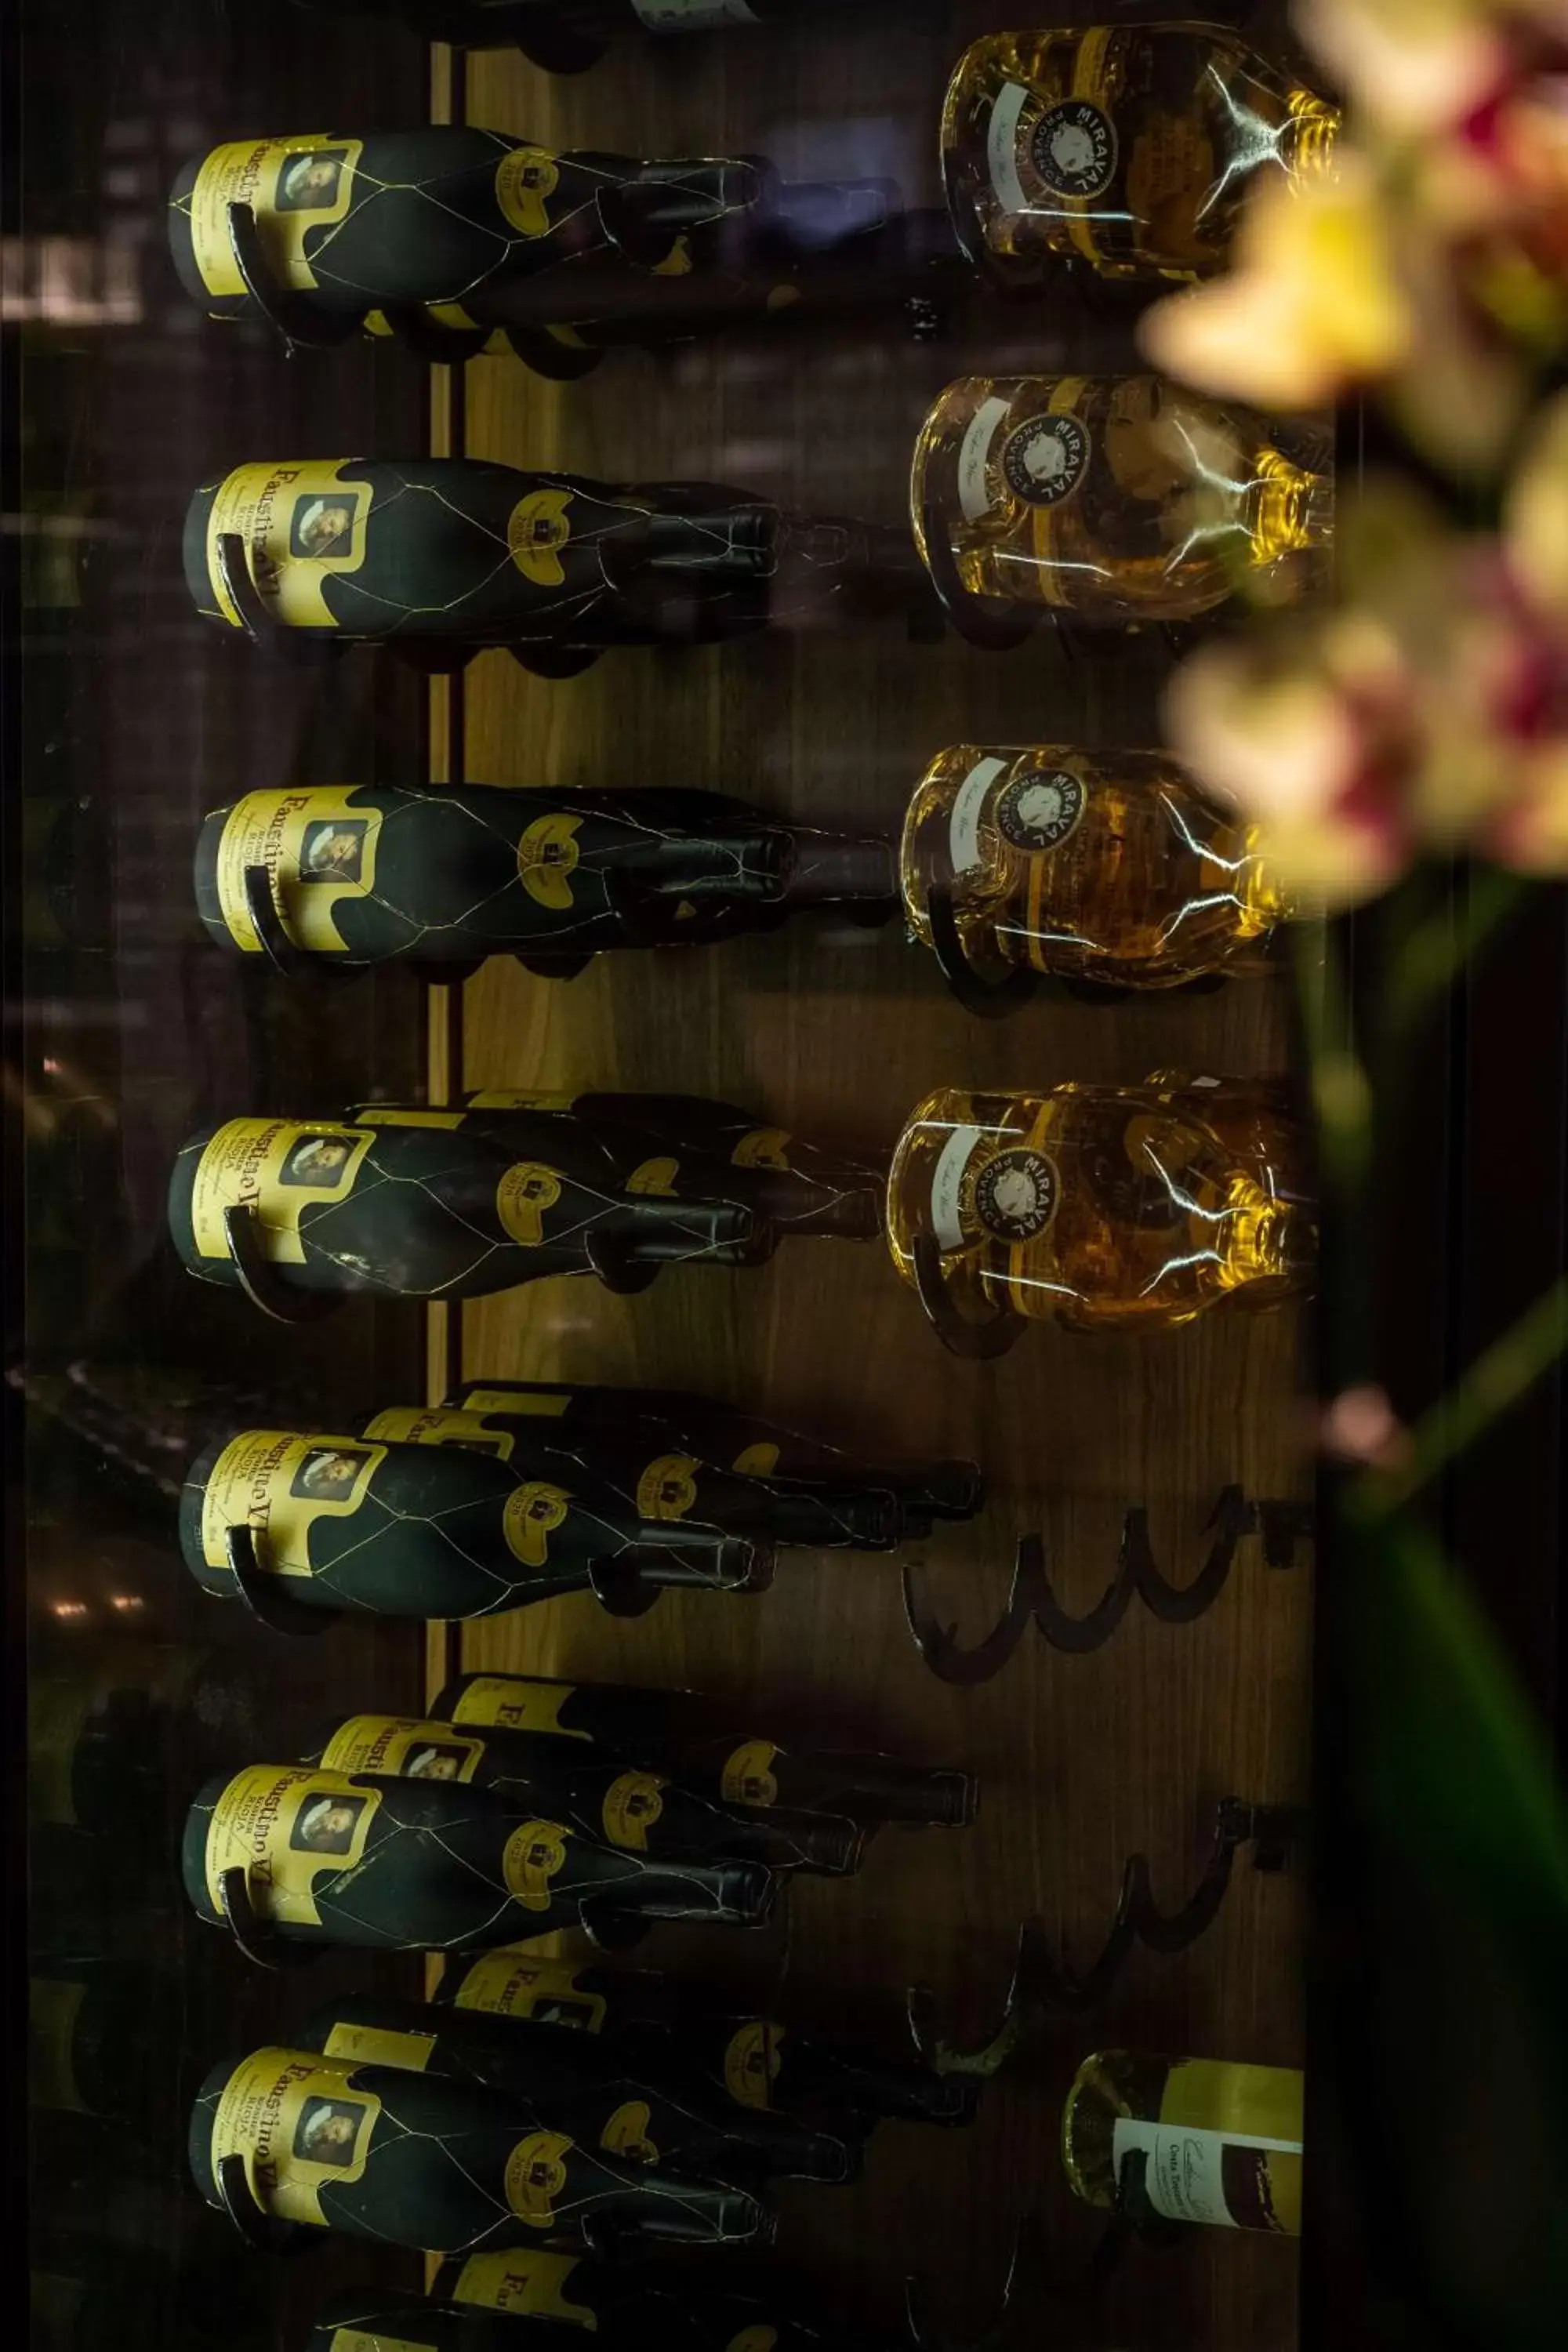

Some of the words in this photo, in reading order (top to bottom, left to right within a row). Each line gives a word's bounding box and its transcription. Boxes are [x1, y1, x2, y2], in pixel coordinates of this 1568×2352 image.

[1034, 110, 1067, 187] PROVENCE
[1074, 107, 1109, 192] MIRAVAL
[1004, 421, 1044, 495] PROVENCE
[1040, 419, 1082, 502] MIRAVAL
[254, 467, 306, 563] Faustino
[1000, 775, 1040, 842] PROVENCE
[1032, 773, 1077, 848] MIRAVAL
[253, 830, 266, 864] KOSHE
[977, 1156, 1013, 1229] PROVENCE
[1011, 1155, 1051, 1237] MIRAVAL
[236, 1796, 257, 1832] RIOJA
[245, 1795, 265, 1835] KOSHER
[254, 1769, 315, 1853] Faustino
[240, 2096, 257, 2134] RIOJA
[255, 2062, 316, 2158] Faustino
[1169, 2144, 1181, 2172] Costa
